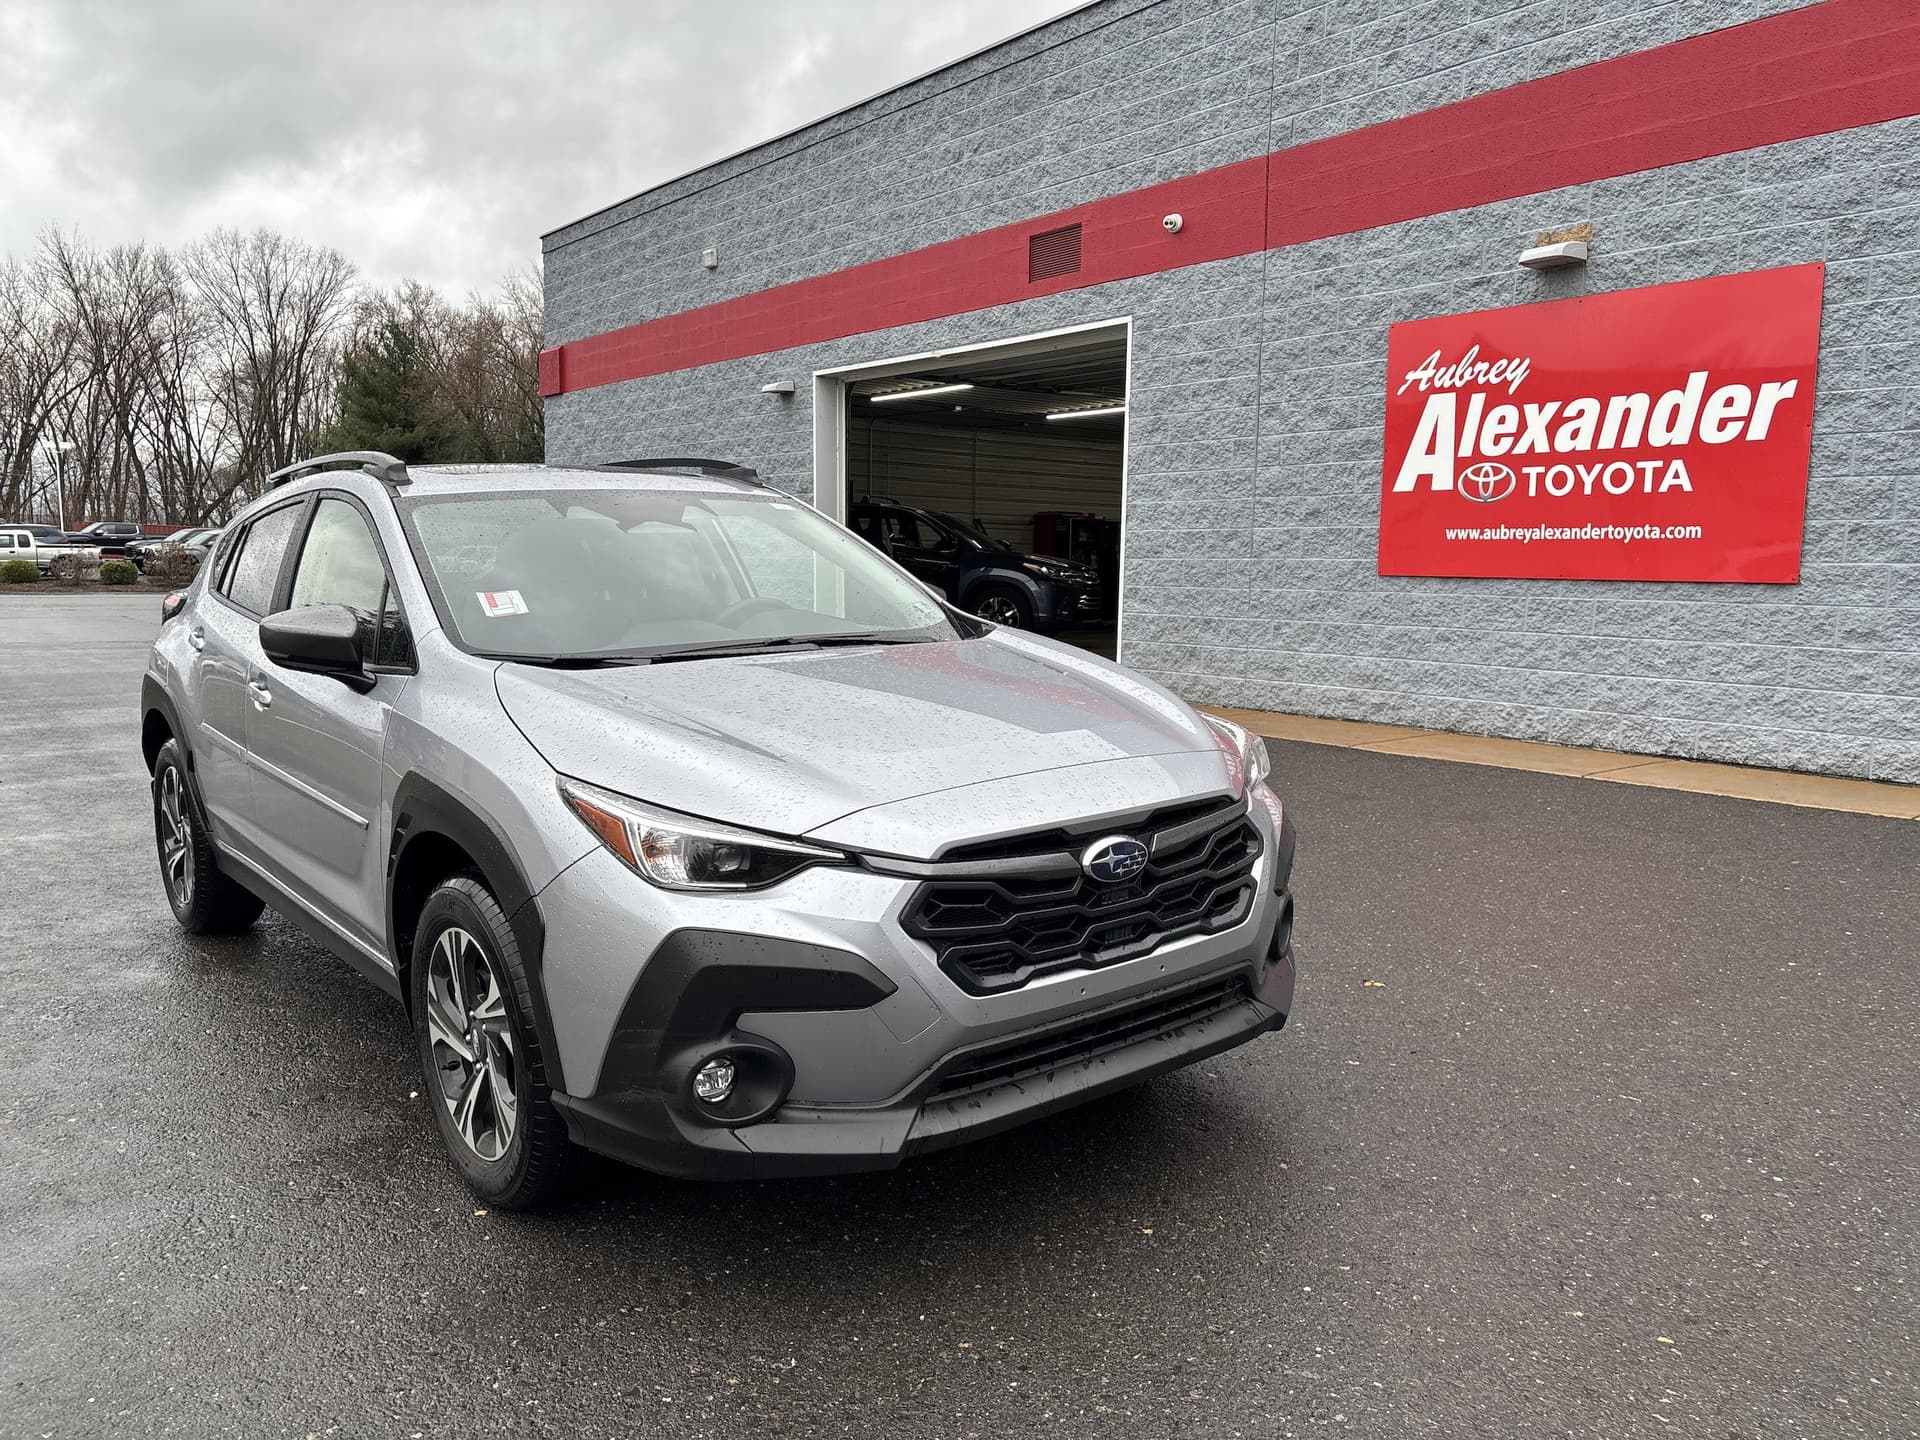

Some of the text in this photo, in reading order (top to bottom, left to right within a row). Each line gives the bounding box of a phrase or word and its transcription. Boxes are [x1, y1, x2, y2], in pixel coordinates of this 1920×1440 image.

[1397, 344, 1530, 395] Aubrey
[1393, 371, 1798, 492] Alexander
[1522, 459, 1693, 497] TOYOTA
[1445, 523, 1702, 544] www.aubreyalexandertoyota.com
